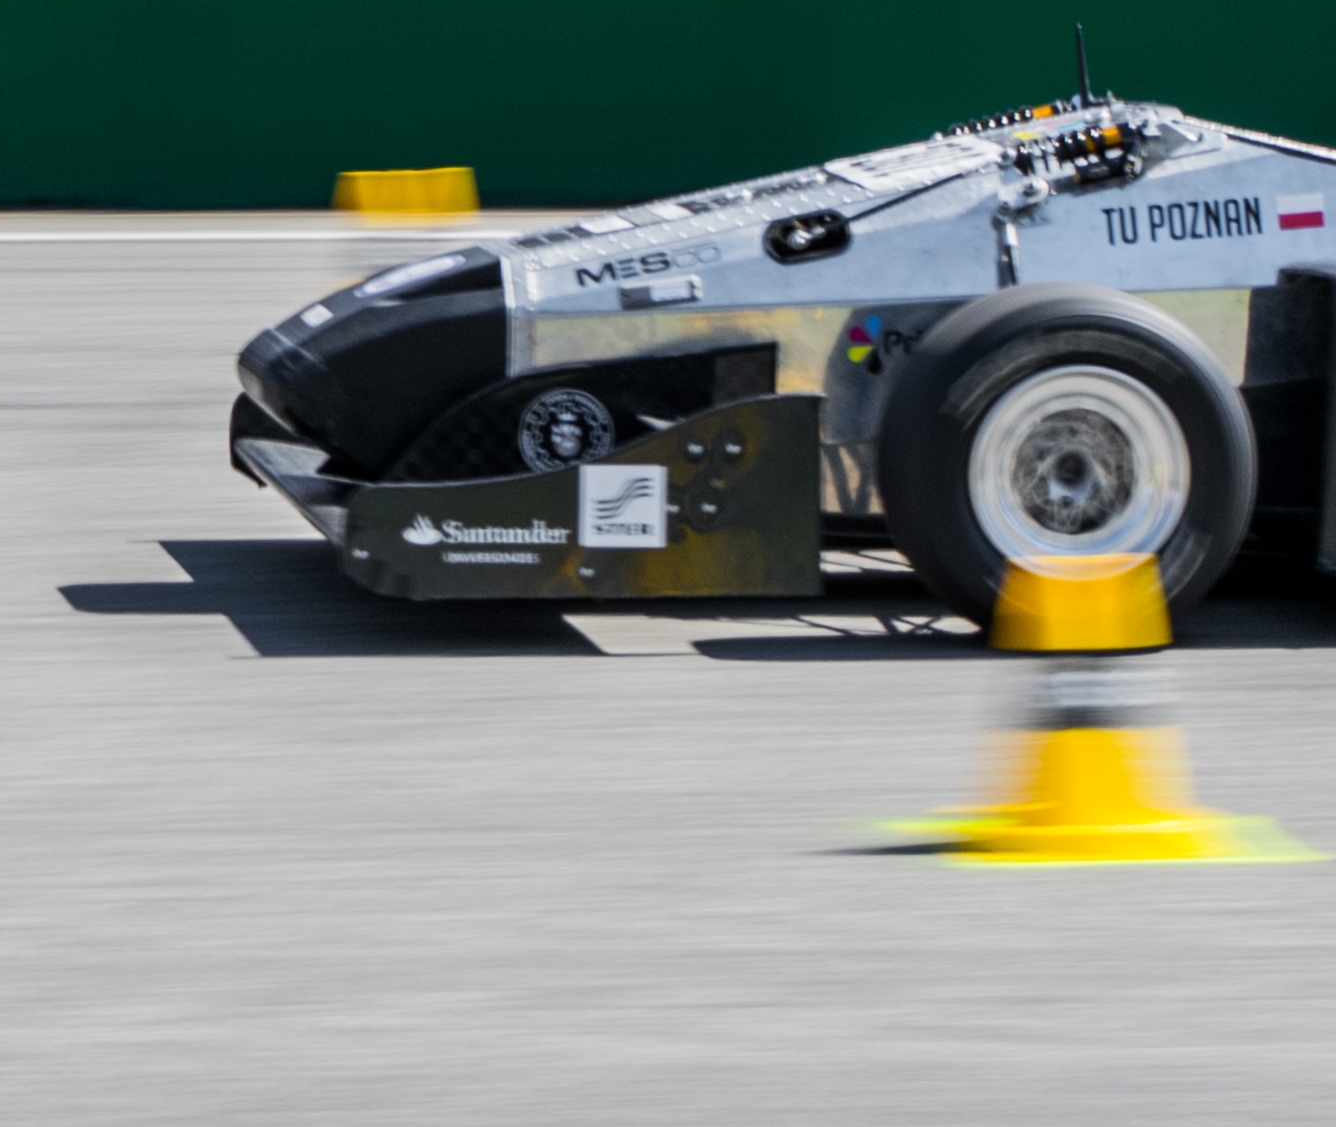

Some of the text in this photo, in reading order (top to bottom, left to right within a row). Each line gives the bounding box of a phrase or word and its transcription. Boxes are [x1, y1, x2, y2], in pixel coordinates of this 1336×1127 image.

[1100, 197, 1264, 247] TU POZNAN
[441, 517, 573, 545] Santander
